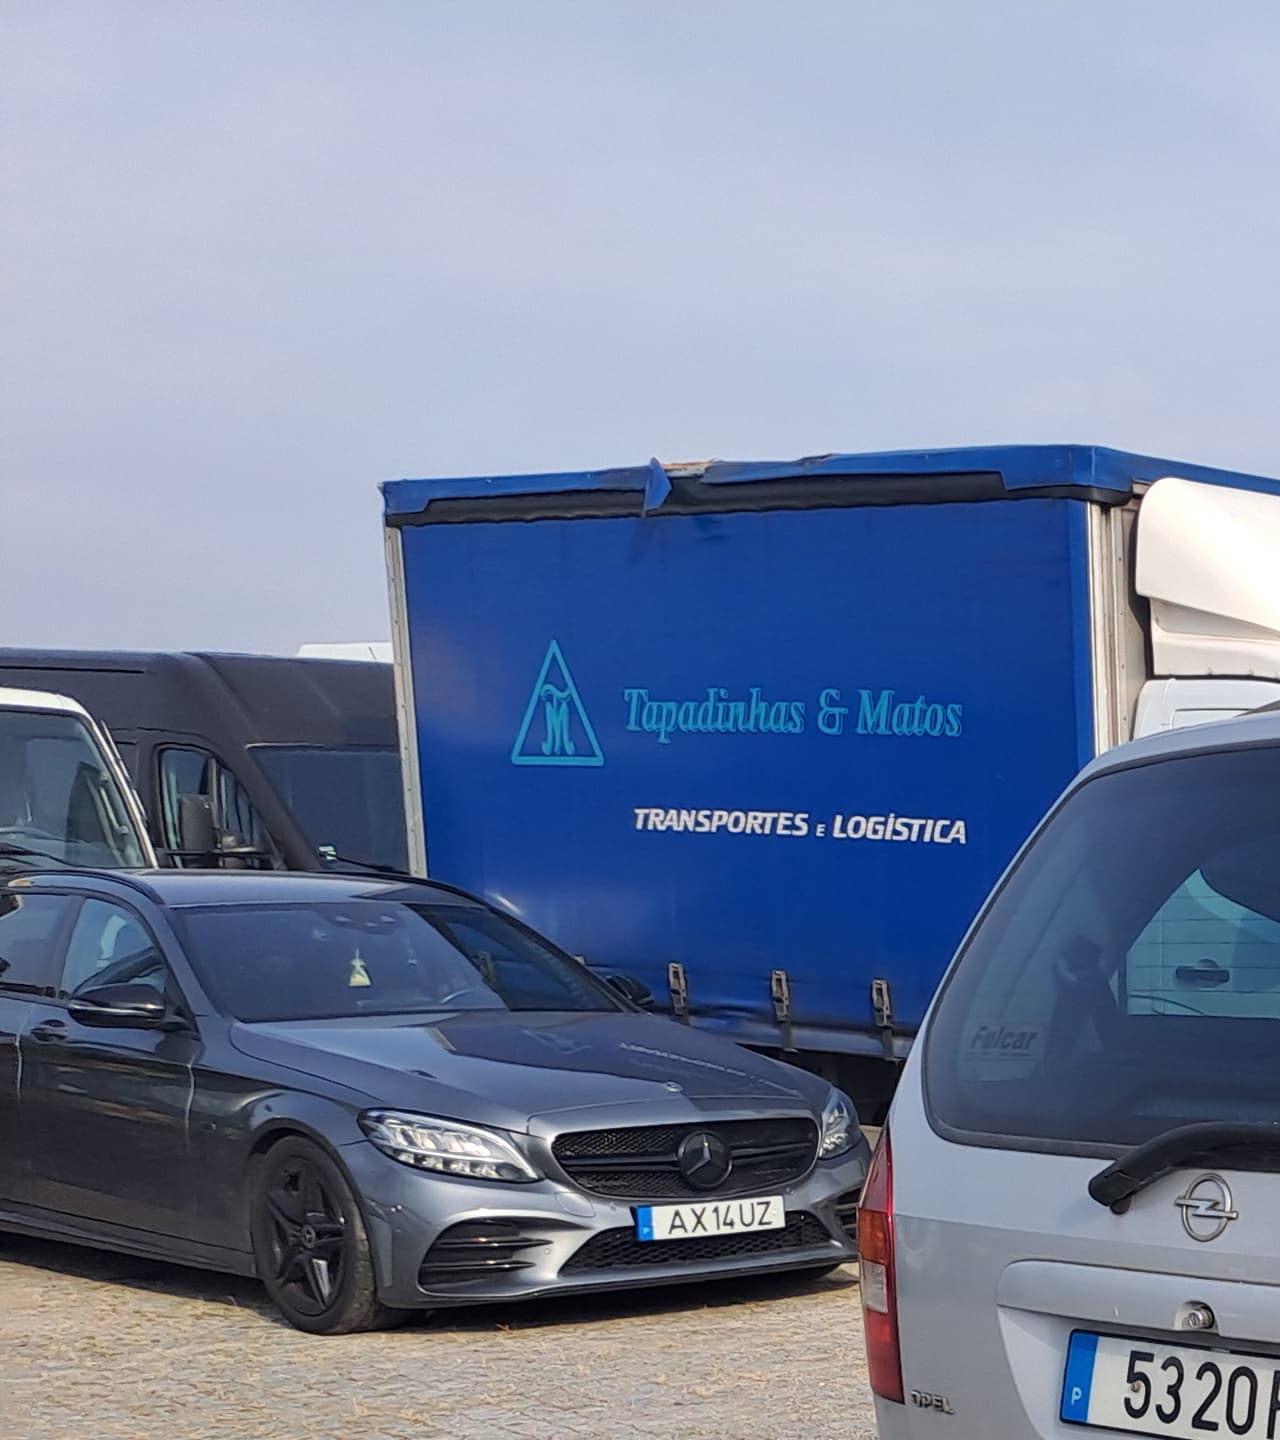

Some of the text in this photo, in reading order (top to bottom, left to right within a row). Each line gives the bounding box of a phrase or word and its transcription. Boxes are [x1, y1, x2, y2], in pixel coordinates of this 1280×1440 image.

[624, 687, 963, 744] Tapadinhas & Matos
[633, 808, 809, 836] TRANSPORTES
[831, 813, 967, 844] LOGÍSTICA
[1071, 1386, 1082, 1406] P
